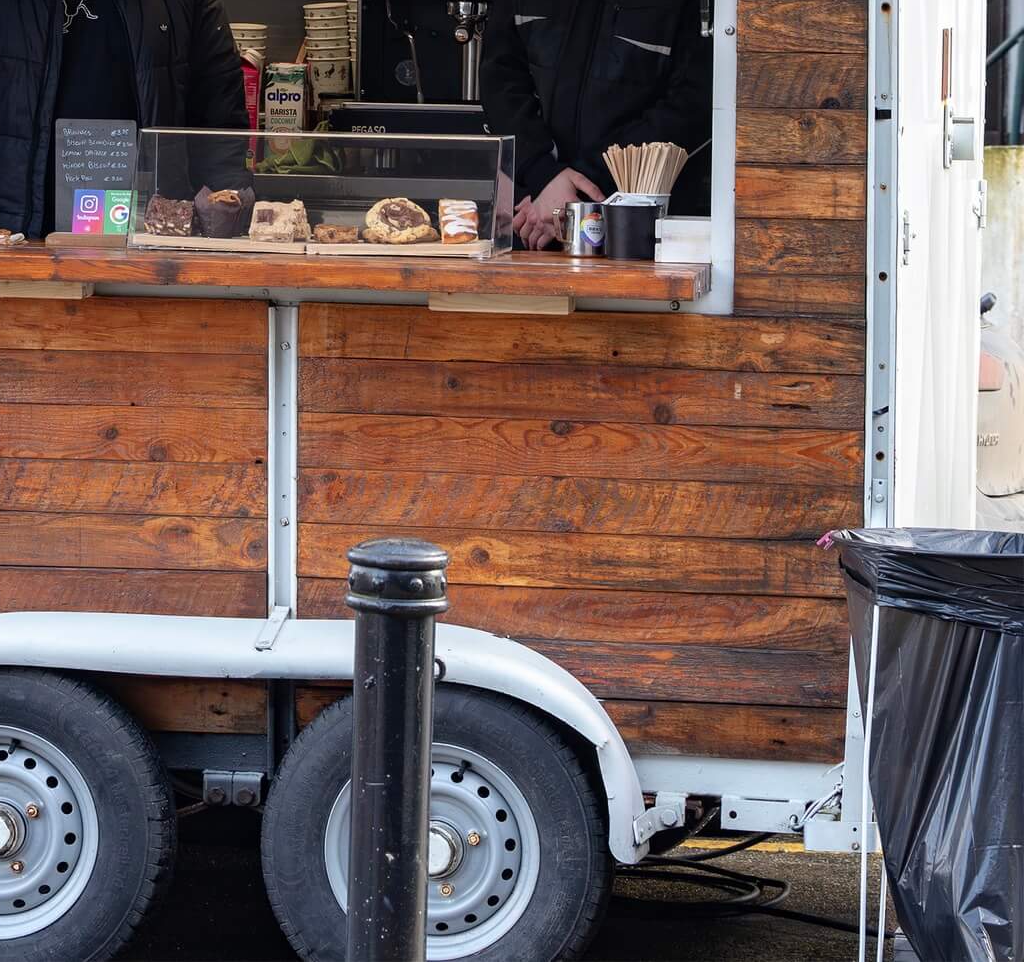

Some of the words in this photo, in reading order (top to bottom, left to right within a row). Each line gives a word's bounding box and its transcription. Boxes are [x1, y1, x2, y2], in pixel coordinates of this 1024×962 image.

[267, 88, 301, 104] alpro
[270, 108, 297, 116] BARISTA
[270, 117, 296, 125] COCONUT
[351, 125, 386, 134] PEGASO
